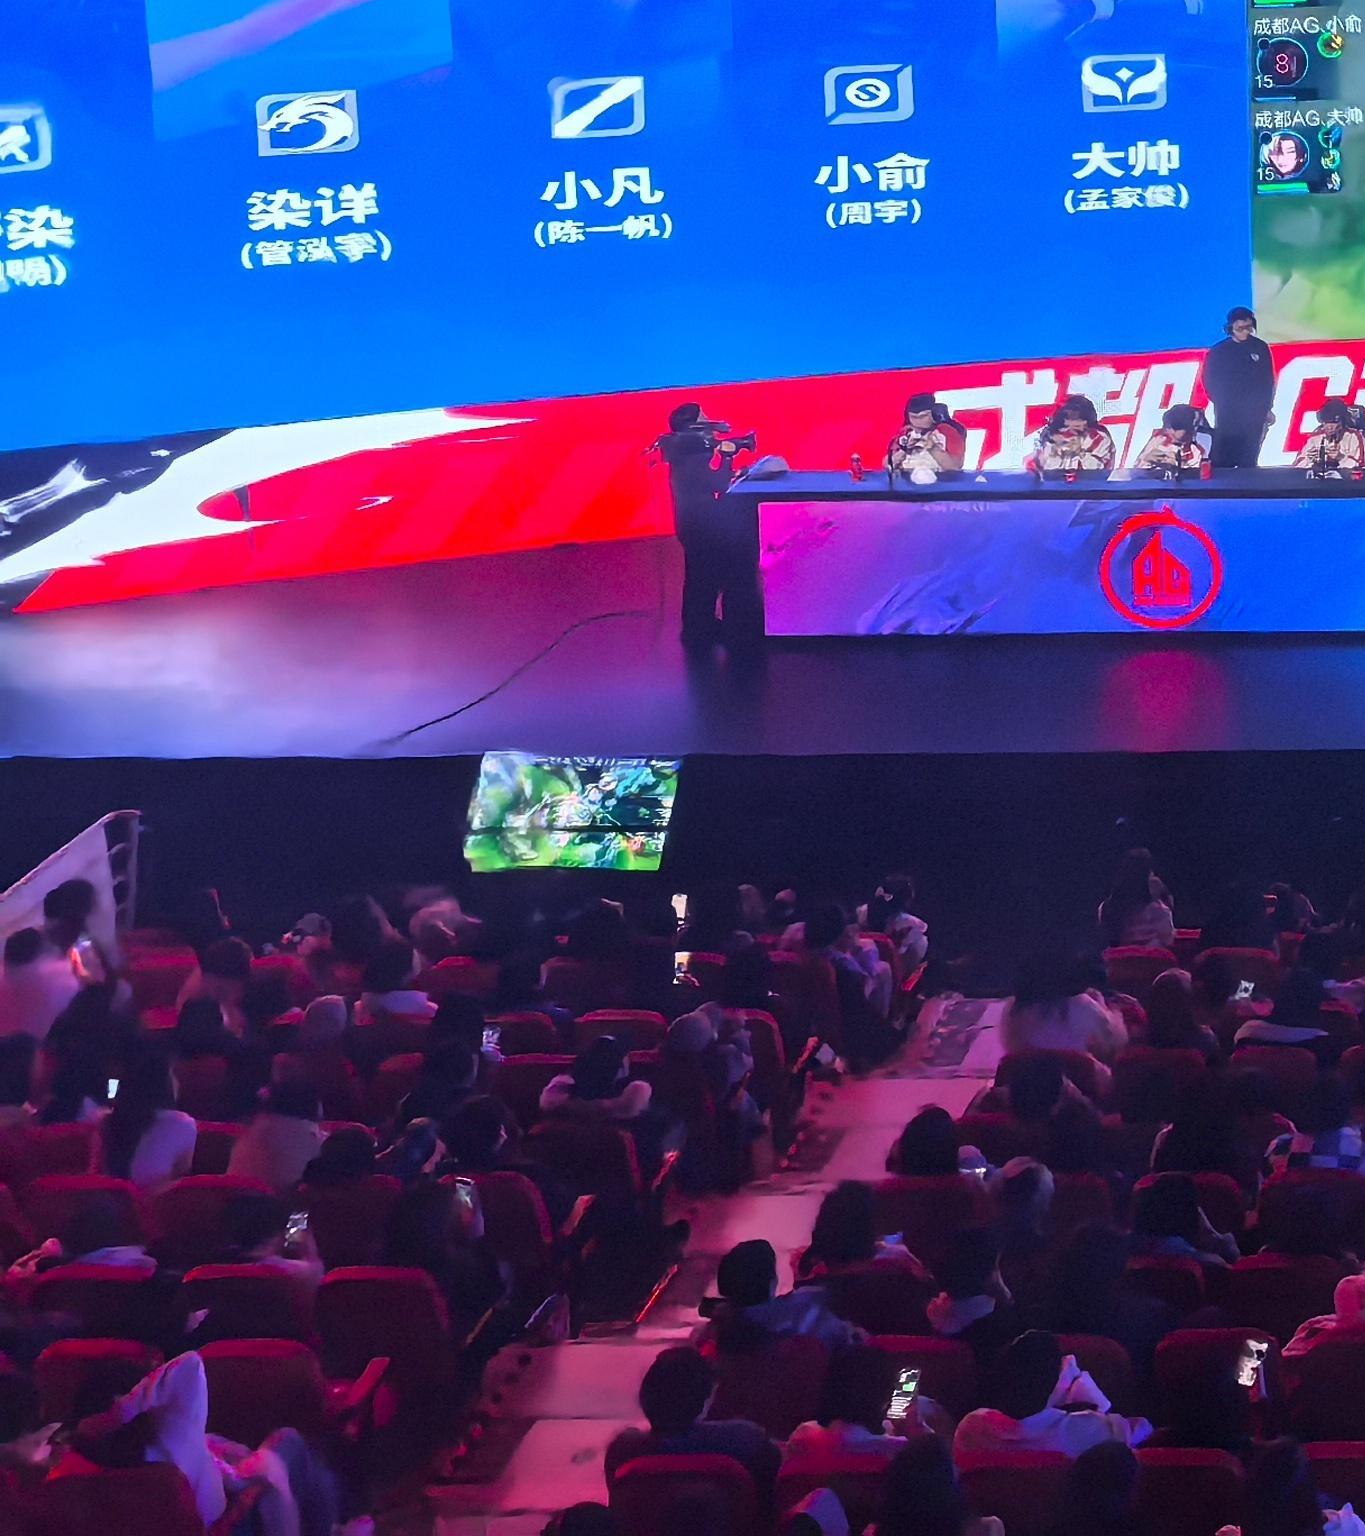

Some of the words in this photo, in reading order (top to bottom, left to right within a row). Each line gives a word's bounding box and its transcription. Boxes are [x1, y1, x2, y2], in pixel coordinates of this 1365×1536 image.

[1254, 74, 1273, 89] 15
[1276, 53, 1289, 73] 8
[814, 152, 931, 194] 小俞
[1072, 138, 1181, 180] 大帅
[1256, 167, 1275, 181] 15
[246, 182, 380, 231] 染详
[540, 166, 665, 211] 小凡
[0, 204, 75, 252] 染
[825, 198, 922, 229] (周宇)
